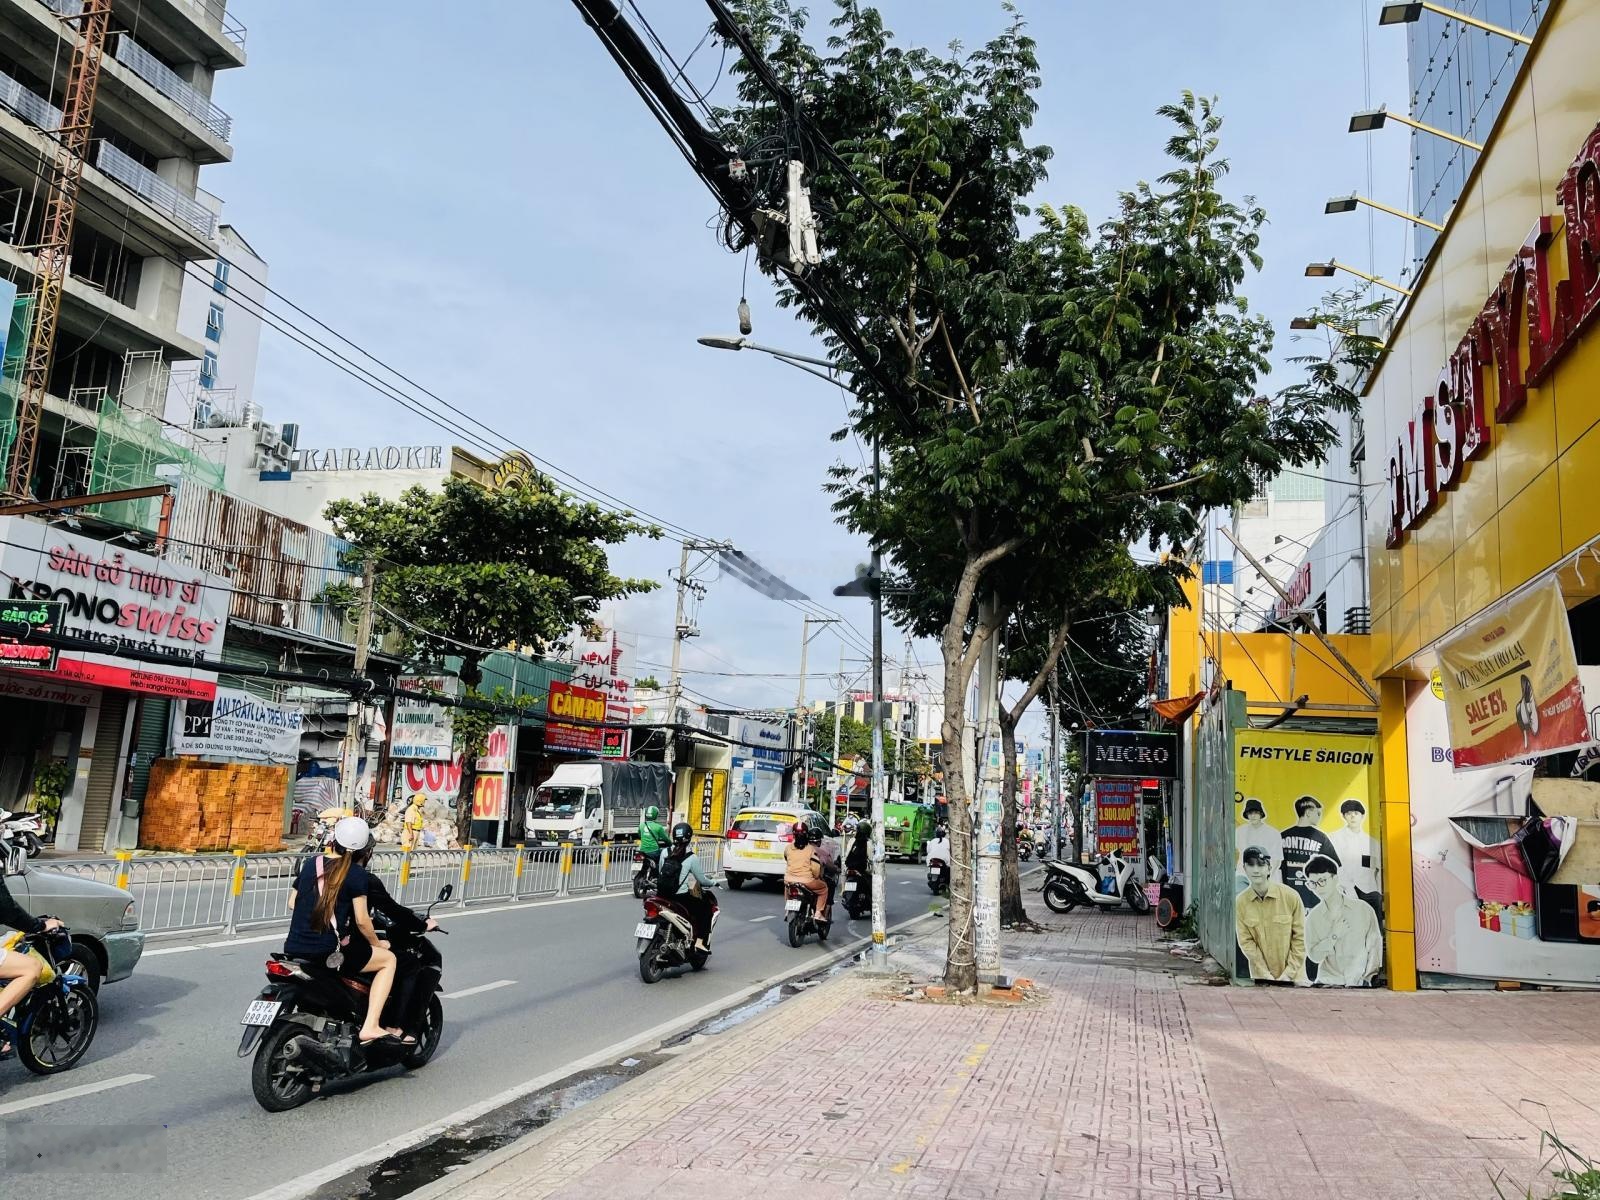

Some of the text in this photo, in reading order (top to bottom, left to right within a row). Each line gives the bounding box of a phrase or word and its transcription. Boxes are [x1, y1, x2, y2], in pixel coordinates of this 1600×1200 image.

[298, 445, 442, 472] KARAOKE
[48, 544, 92, 578] SÀN
[95, 551, 126, 586] GỖ
[129, 566, 178, 600] THỤY
[28, 604, 49, 624] GỖ
[580, 651, 610, 668] NỆM
[395, 713, 434, 724] ALUMINIUM
[1465, 696, 1490, 725] SALE
[184, 715, 212, 734] CPT
[392, 743, 413, 756] NHÔM
[1095, 745, 1170, 765] MICRO
[1240, 746, 1374, 766] FMSTYLE SAIGON
[701, 771, 714, 832] KARAOKE
